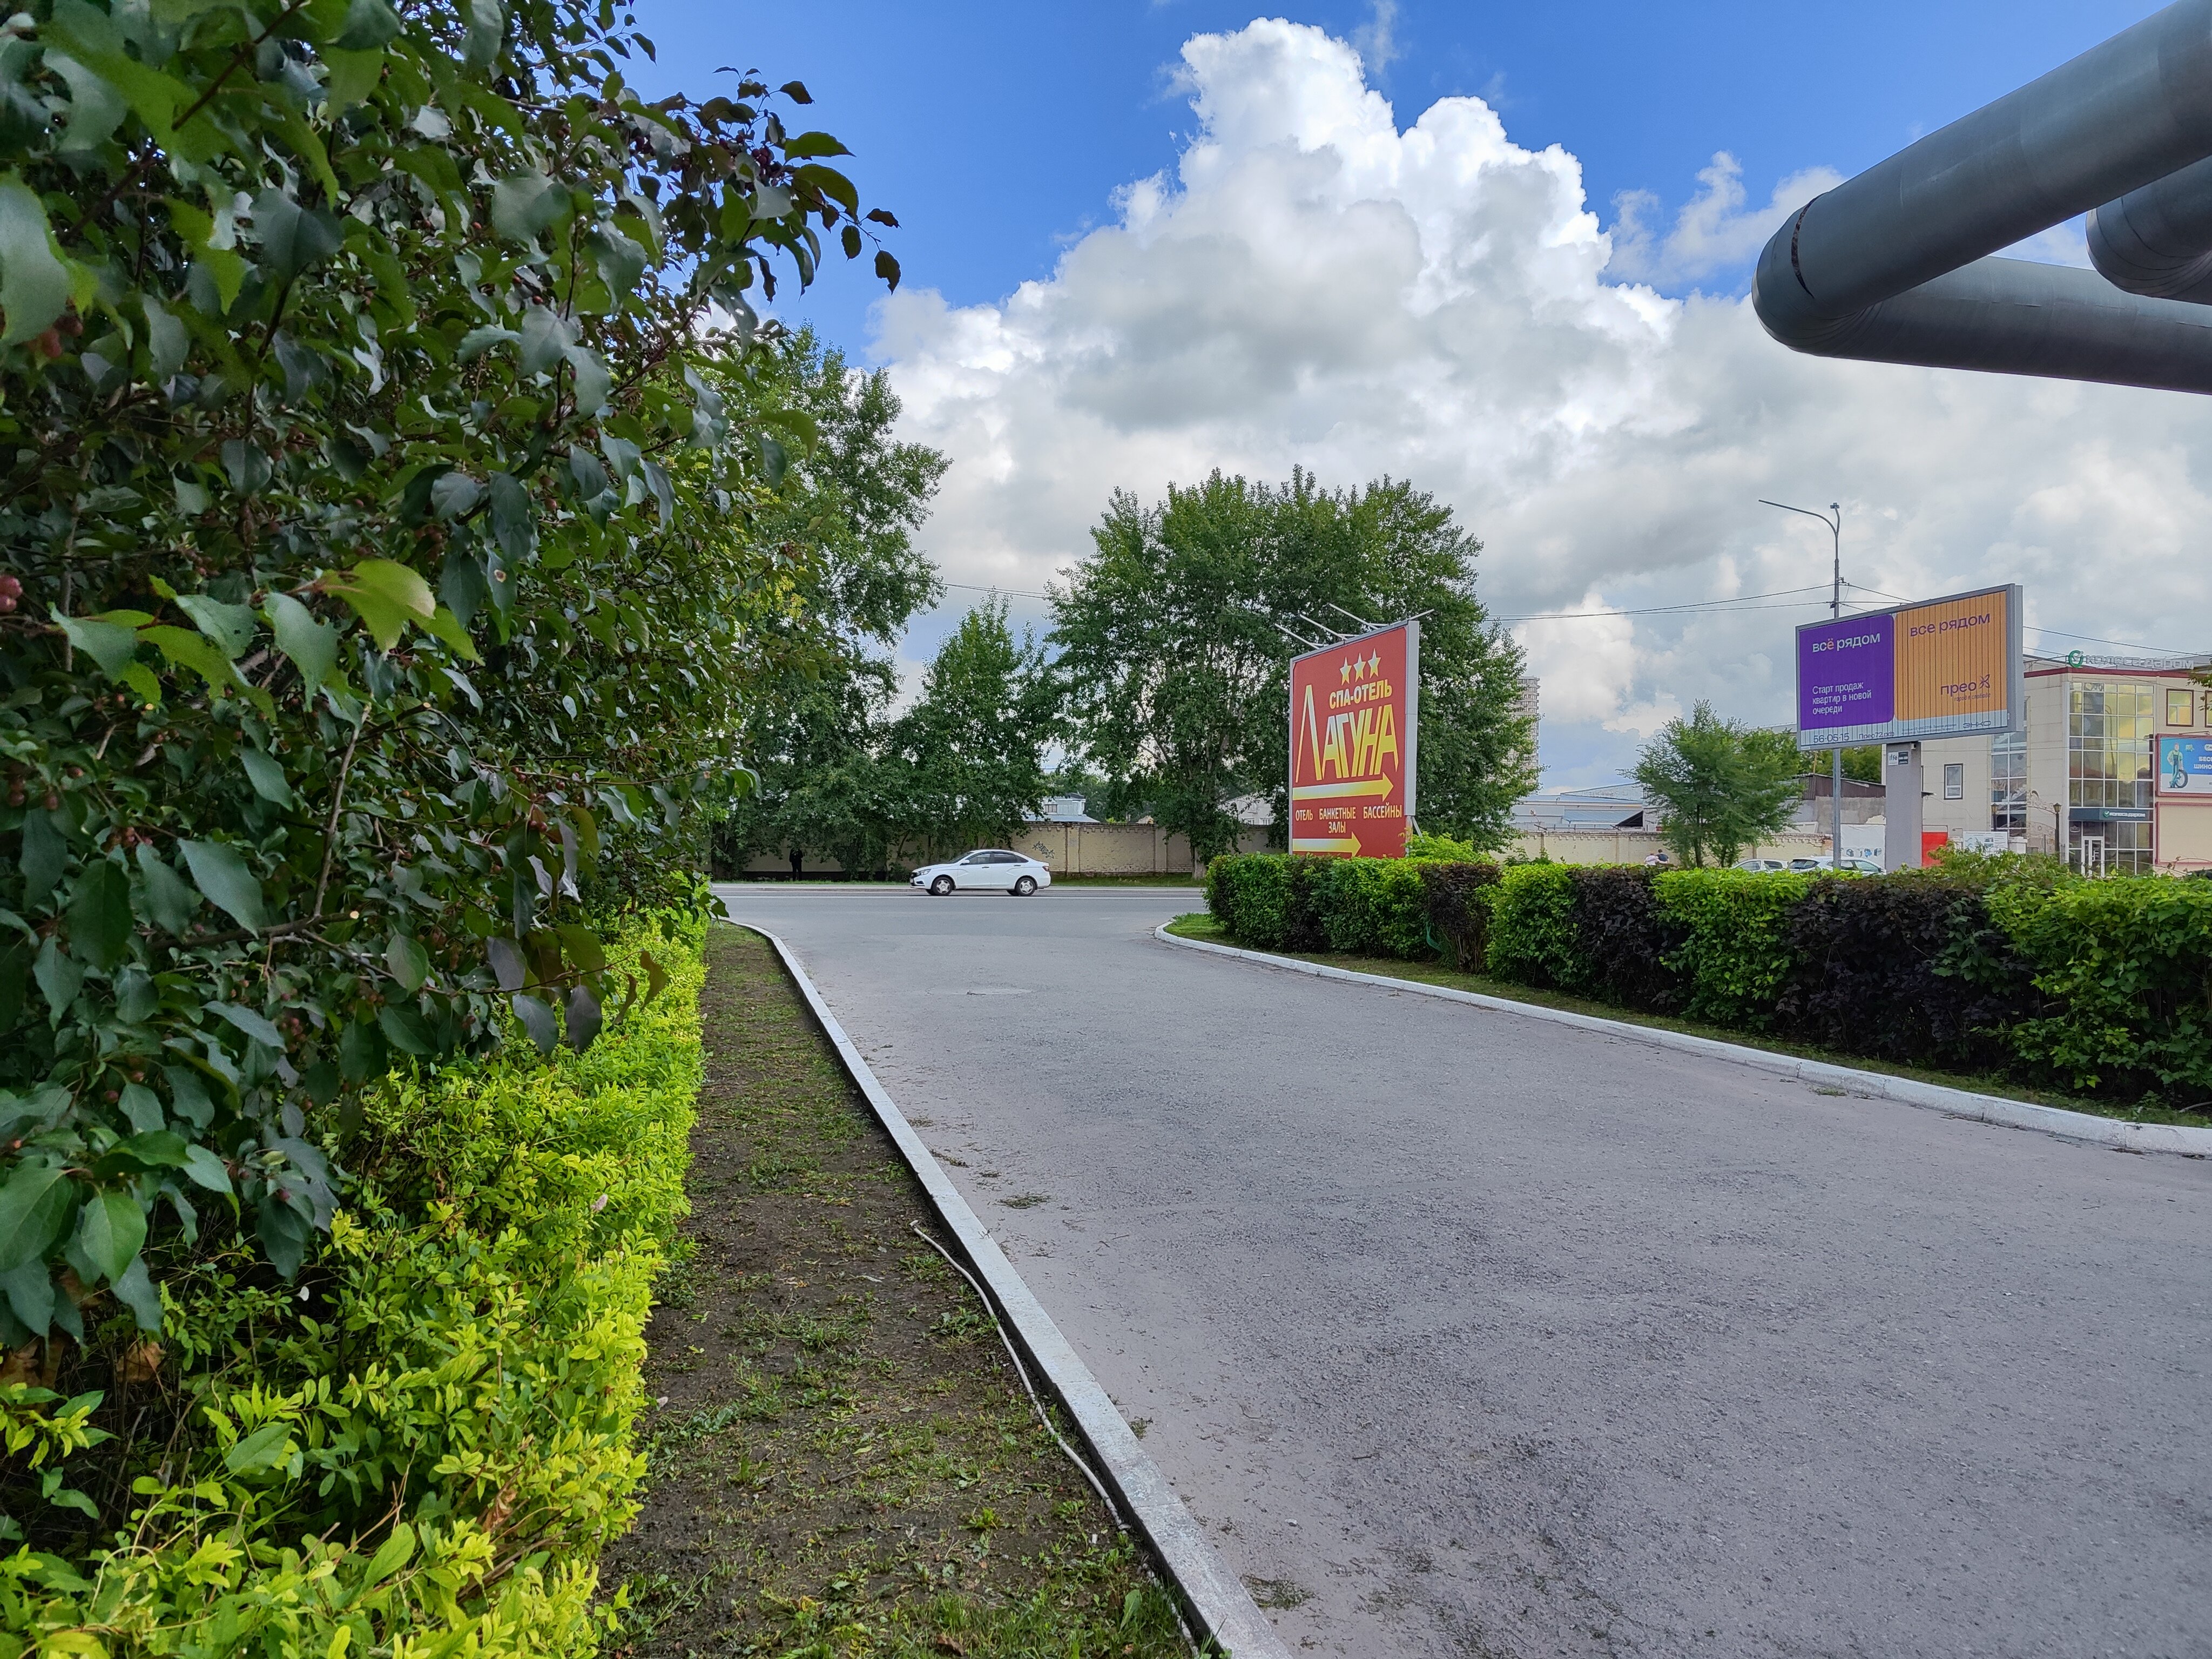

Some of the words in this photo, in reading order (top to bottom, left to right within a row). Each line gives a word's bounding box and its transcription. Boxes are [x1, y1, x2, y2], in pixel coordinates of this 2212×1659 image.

[1910, 623, 1936, 637] все
[1939, 613, 1990, 634] рядом
[1812, 638, 1835, 653] всё
[1836, 632, 1880, 651] рядом
[2086, 655, 2140, 666] колеса
[2142, 658, 2194, 670] даром
[1328, 679, 1393, 710] СПА-ОТЕЛЬ
[1812, 684, 1834, 695] Старт
[1835, 682, 1864, 693] продаж
[1940, 682, 1977, 697] прео
[1812, 694, 1841, 705] квартир
[1849, 690, 1872, 701] новой
[1812, 705, 1843, 716] очереди
[1963, 720, 1992, 729] ЭНКО
[1813, 732, 1850, 744] 56-05-15
[1295, 809, 1314, 821] ОТЕЛЬ
[1319, 807, 1357, 820] БАНКЕТНЫЕ
[1363, 802, 1402, 819] БАССЕЙНЫ
[1328, 821, 1346, 834] ЗАЛЫ
